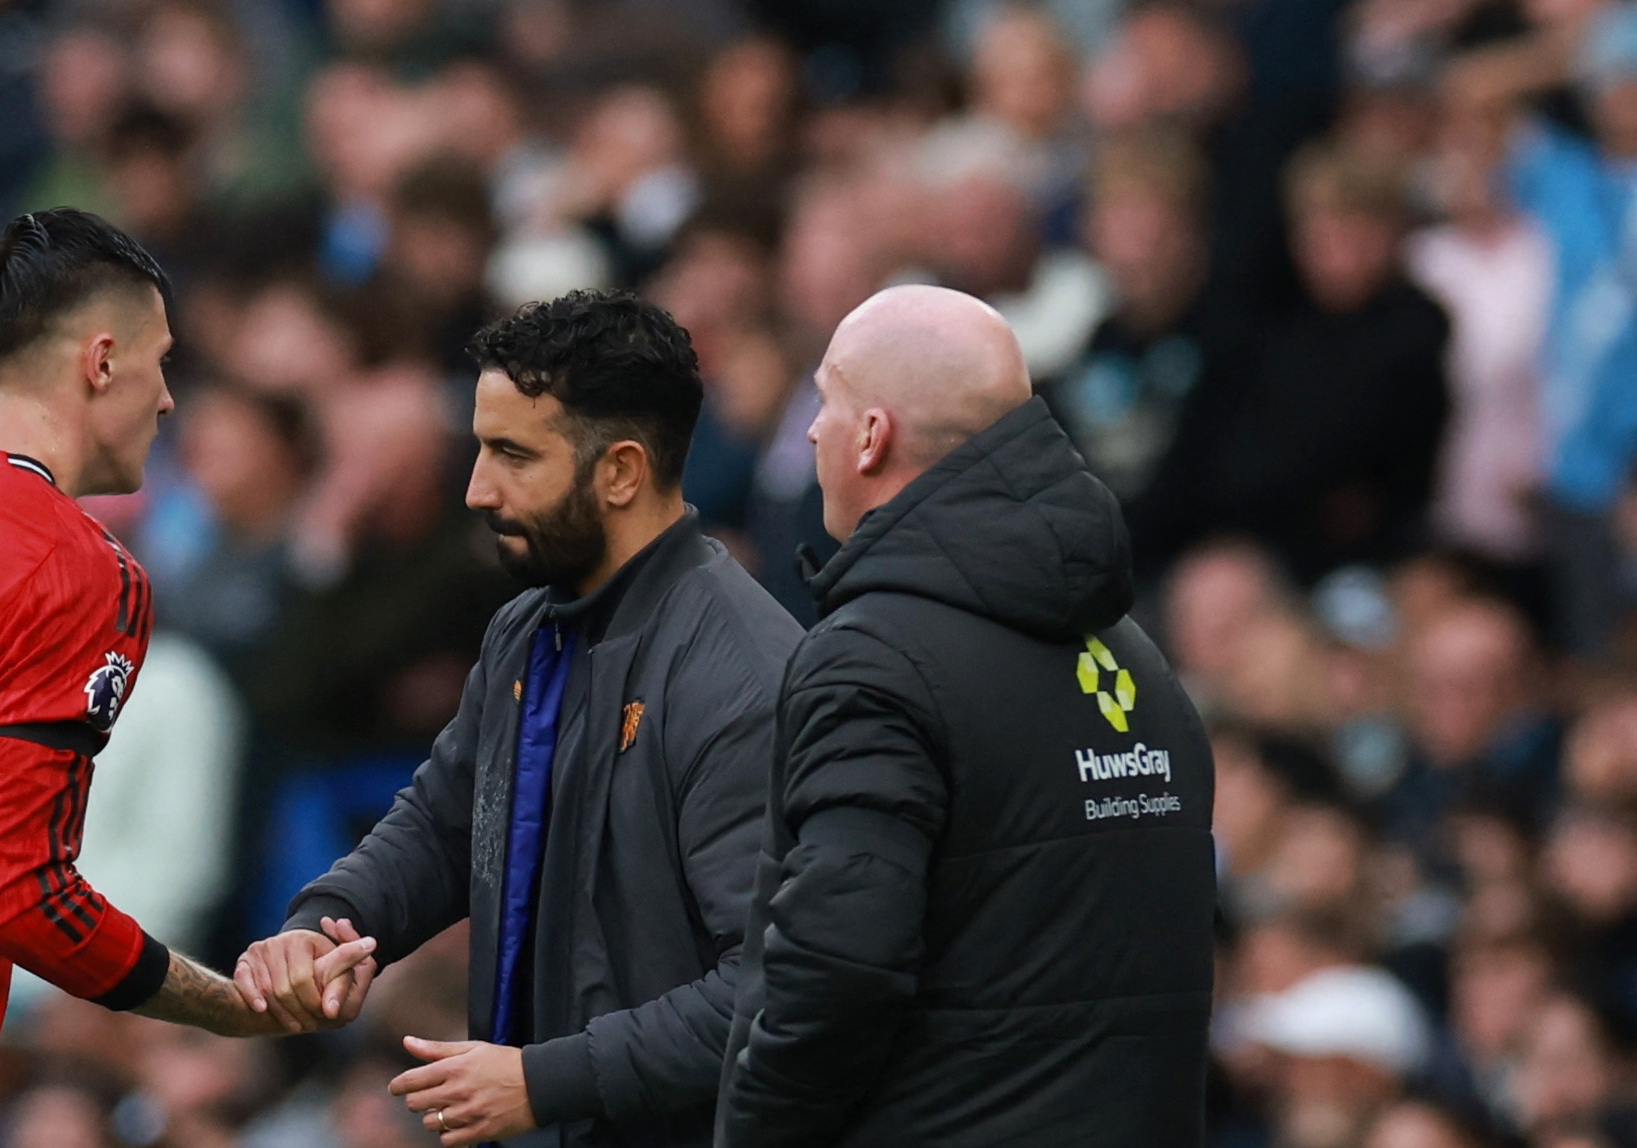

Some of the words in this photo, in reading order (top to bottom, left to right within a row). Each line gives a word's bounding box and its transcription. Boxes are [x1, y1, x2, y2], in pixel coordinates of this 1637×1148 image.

[1075, 742, 1171, 782] HuwsGray
[1085, 796, 1140, 820] Building
[1138, 791, 1181, 817] Supplies
